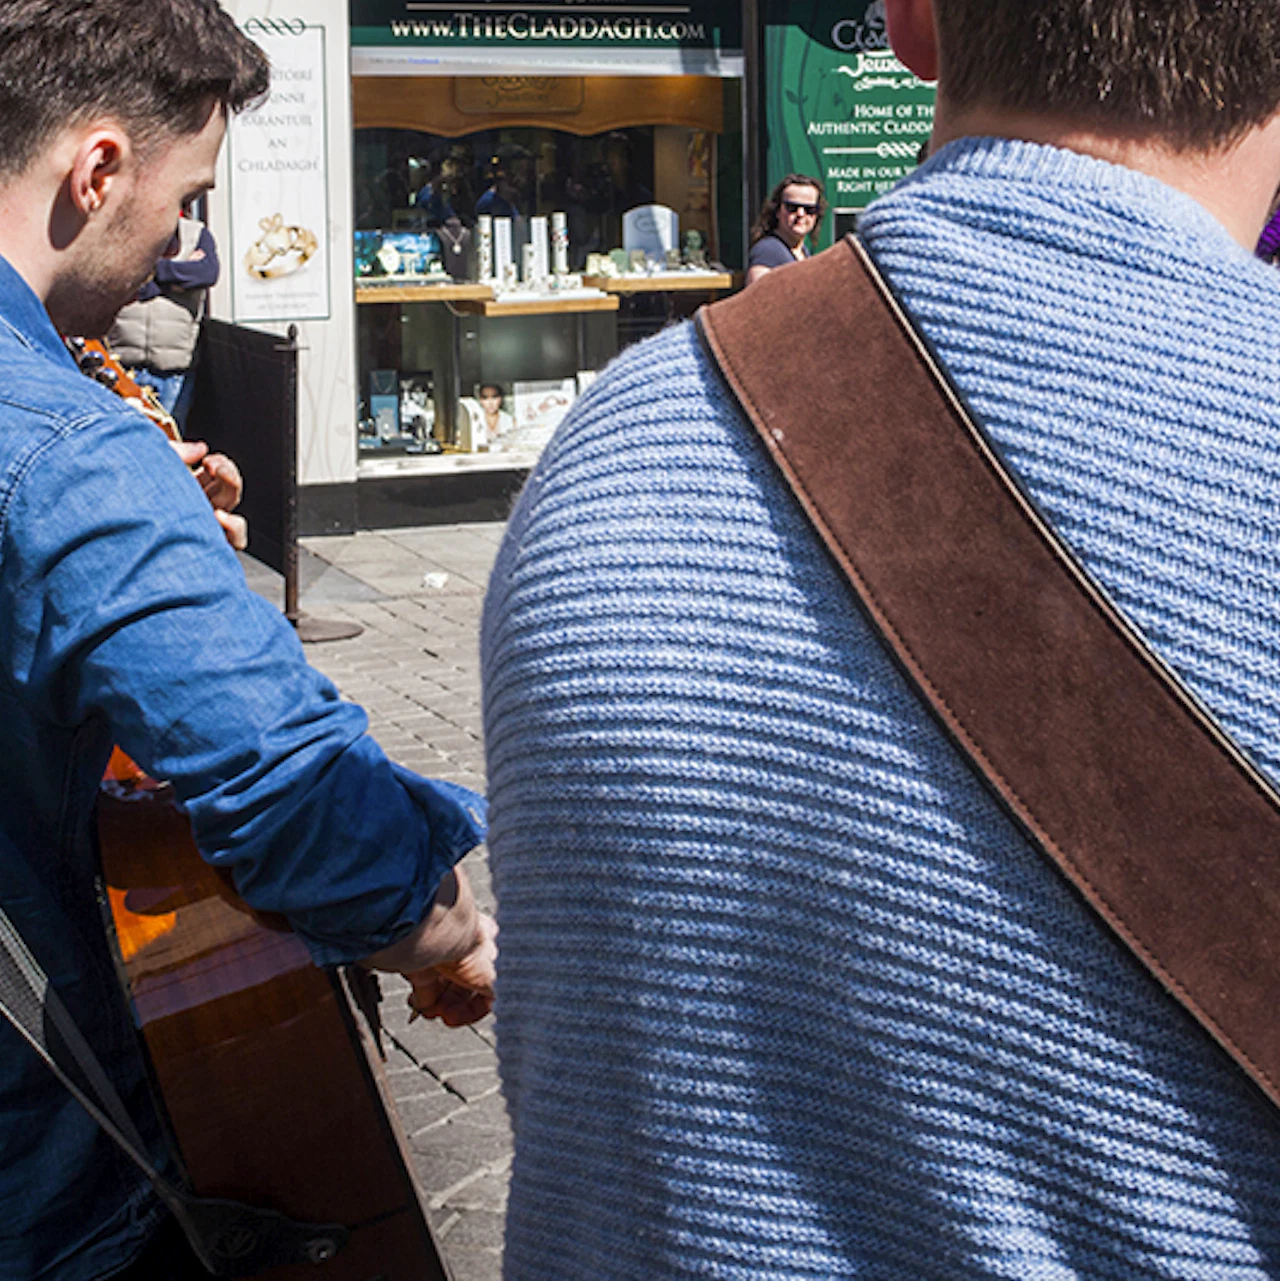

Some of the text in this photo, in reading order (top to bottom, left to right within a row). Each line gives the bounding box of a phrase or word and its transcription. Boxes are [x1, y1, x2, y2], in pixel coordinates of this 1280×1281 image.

[854, 104, 935, 119] HOME OF TH
[807, 121, 935, 136] AUTHENTIC CLADDA
[268, 138, 287, 149] AN
[828, 167, 859, 179] MADE
[863, 167, 876, 179] IN
[877, 167, 903, 179] OUR
[836, 181, 897, 193] RIGHT HER
